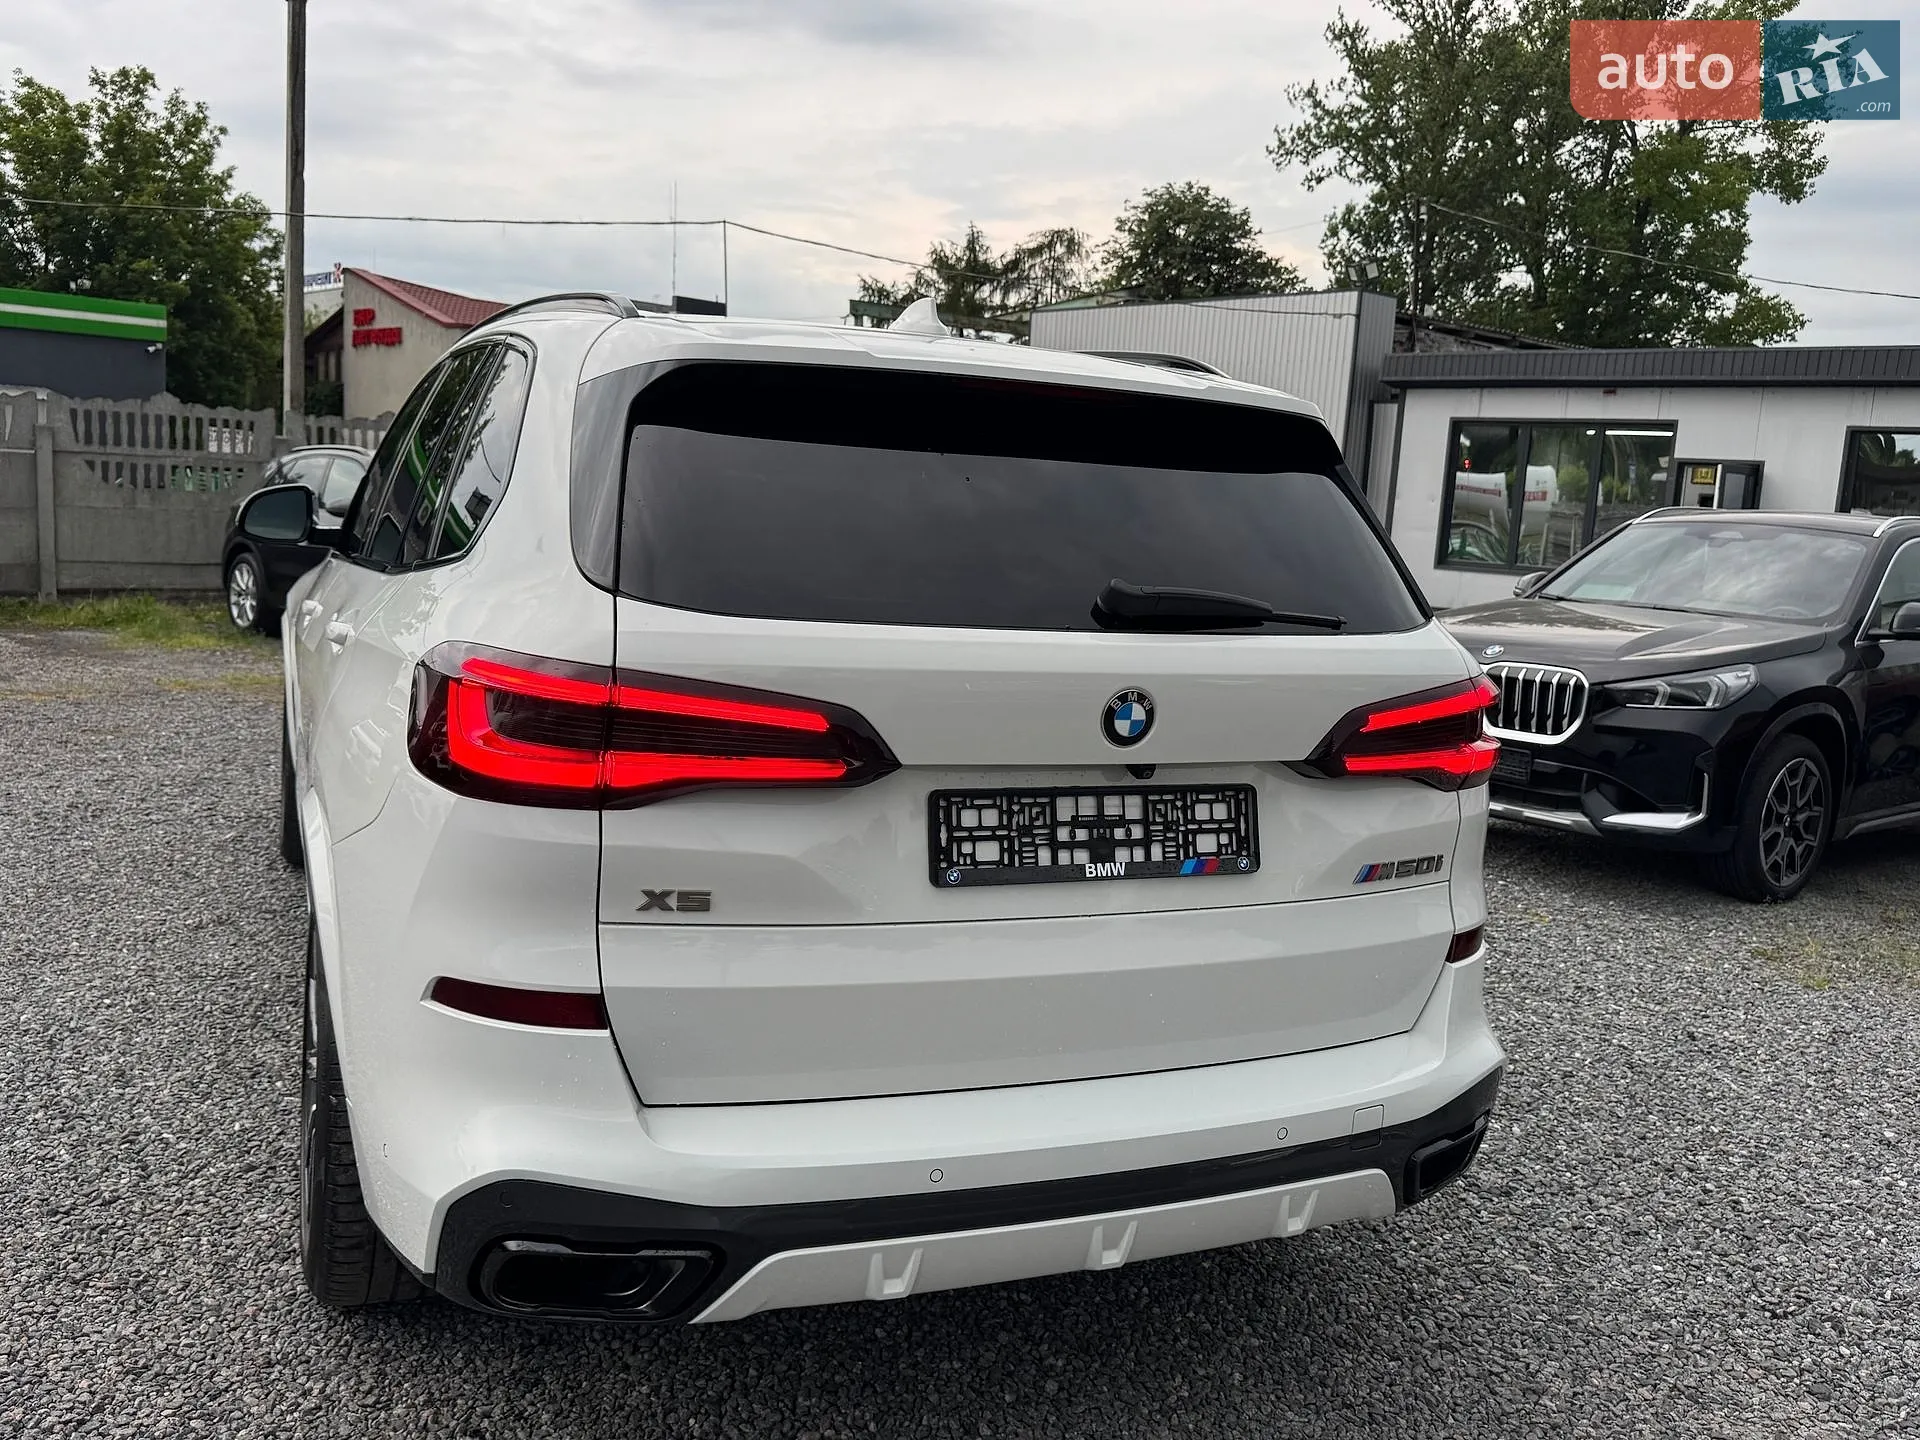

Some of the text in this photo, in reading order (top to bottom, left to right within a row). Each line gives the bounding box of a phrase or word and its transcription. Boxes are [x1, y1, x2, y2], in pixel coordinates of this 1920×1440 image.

[1110, 691, 1153, 711] BMW
[1085, 862, 1126, 878] BMW
[635, 888, 712, 913] X5
